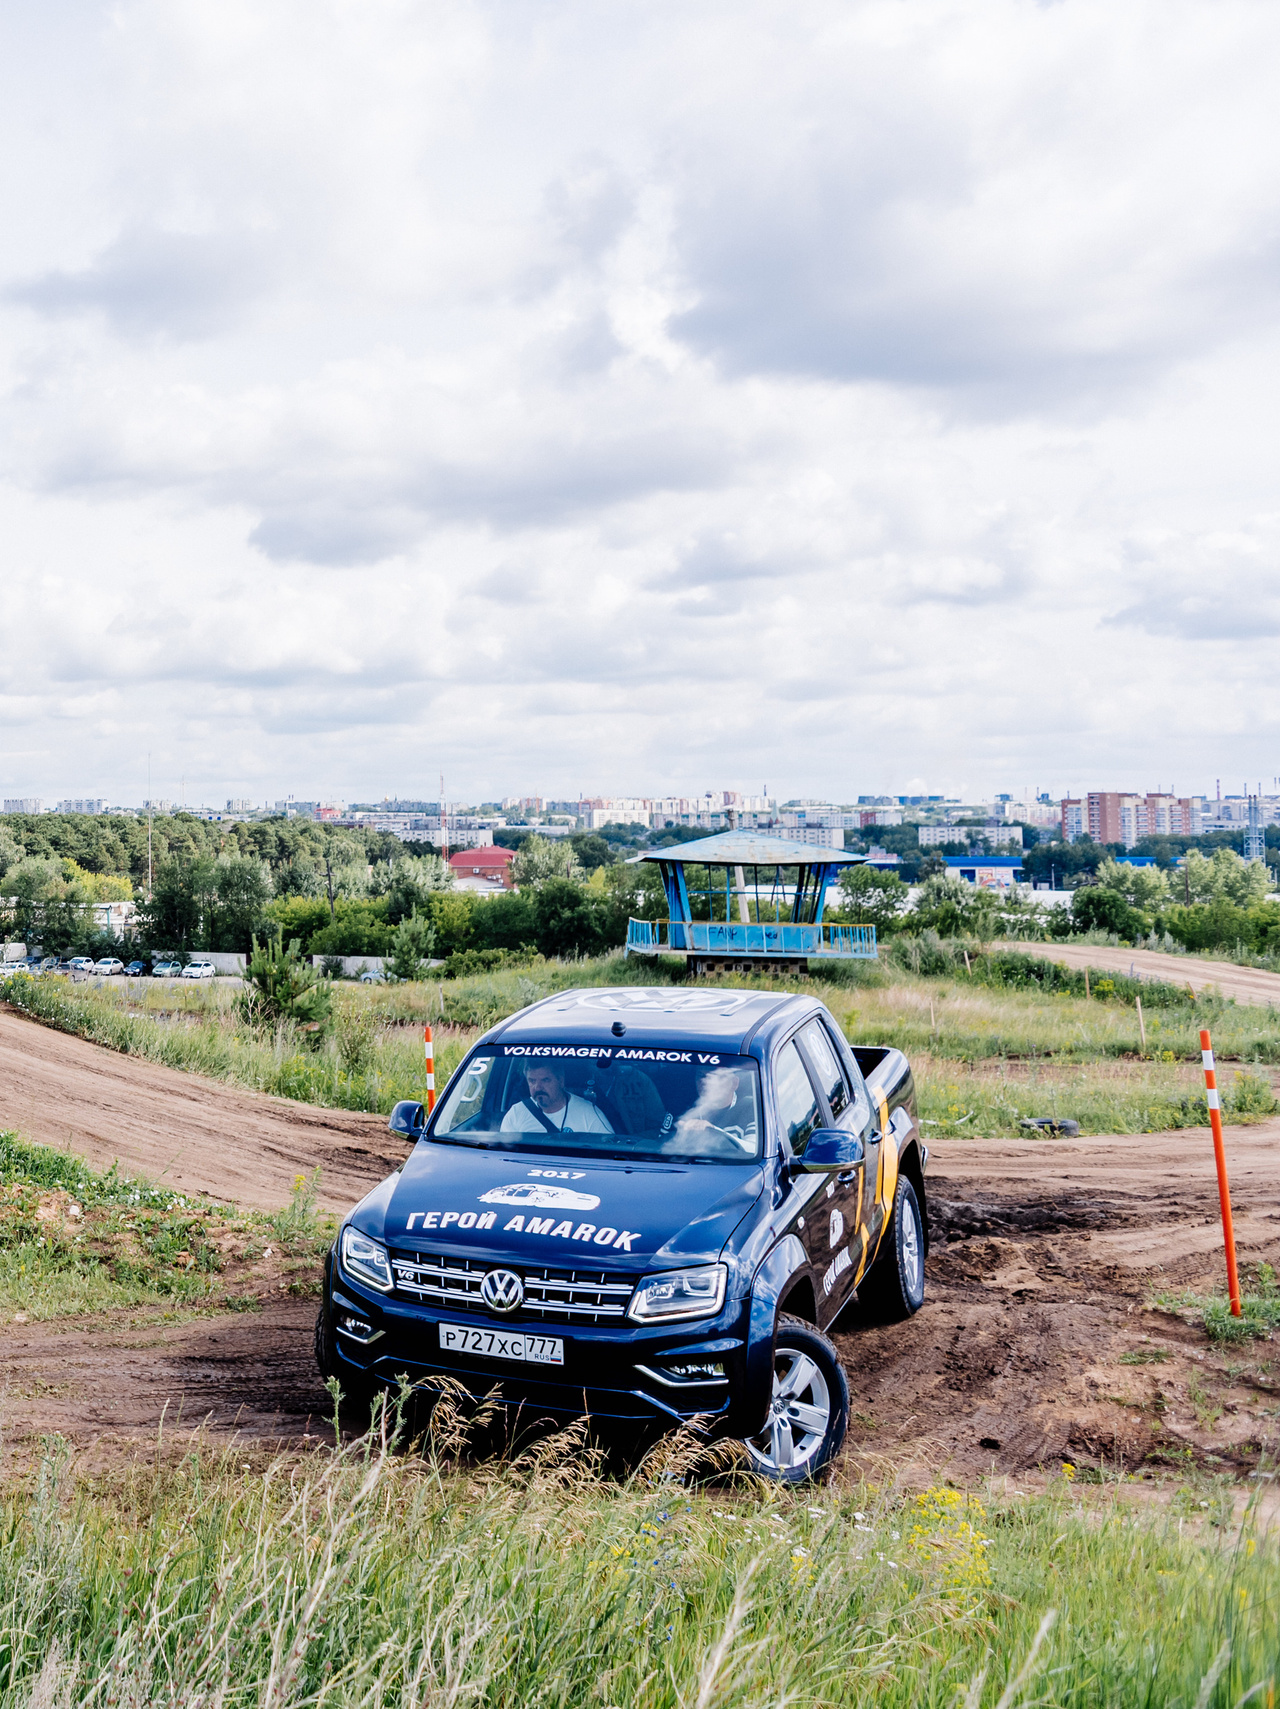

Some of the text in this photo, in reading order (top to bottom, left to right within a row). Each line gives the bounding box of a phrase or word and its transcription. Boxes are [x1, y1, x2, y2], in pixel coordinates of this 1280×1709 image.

[503, 1046, 721, 1065] VOLKSWAGEN AMAROK V6
[468, 1057, 491, 1075] 5
[526, 1169, 587, 1180] 2017
[405, 1211, 642, 1251] ГЕРОЙ AMAROK
[397, 1269, 415, 1281] V6
[534, 1353, 550, 1361] RUS
